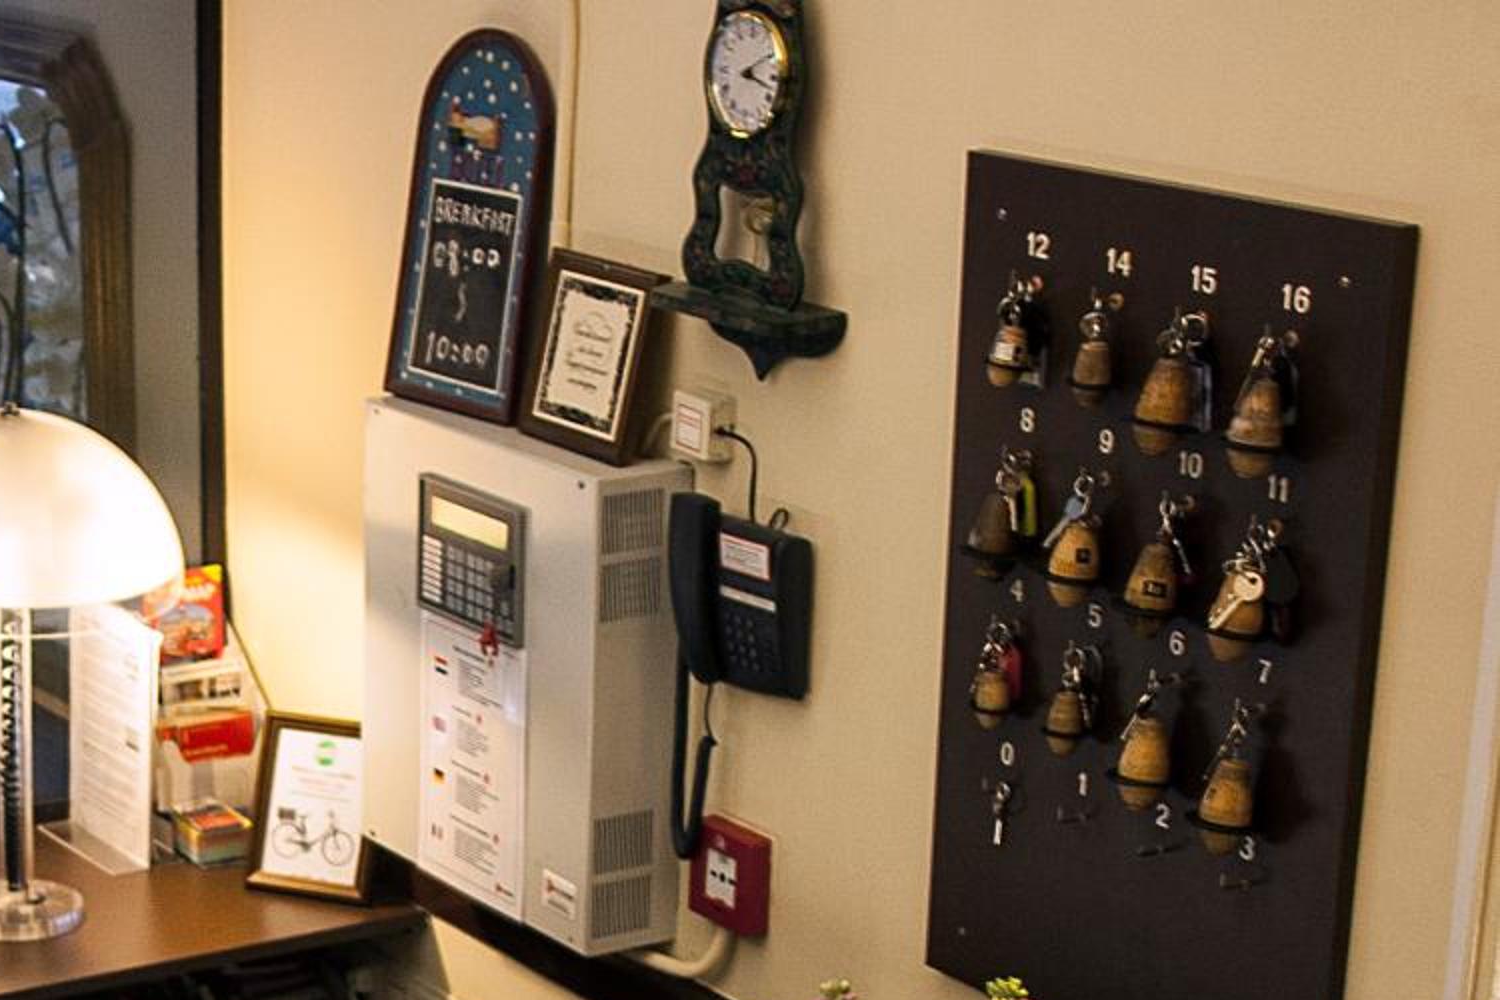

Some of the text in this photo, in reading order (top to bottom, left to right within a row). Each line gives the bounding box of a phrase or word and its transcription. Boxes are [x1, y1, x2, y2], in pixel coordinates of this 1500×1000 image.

[1026, 230, 1313, 315] 12 14 15 16
[425, 330, 490, 370] 10:00
[1019, 406, 1290, 504] 8 9 10 11
[1009, 578, 1273, 685] 4 5 6 7
[1000, 740, 1255, 862] 0 1 2 3
